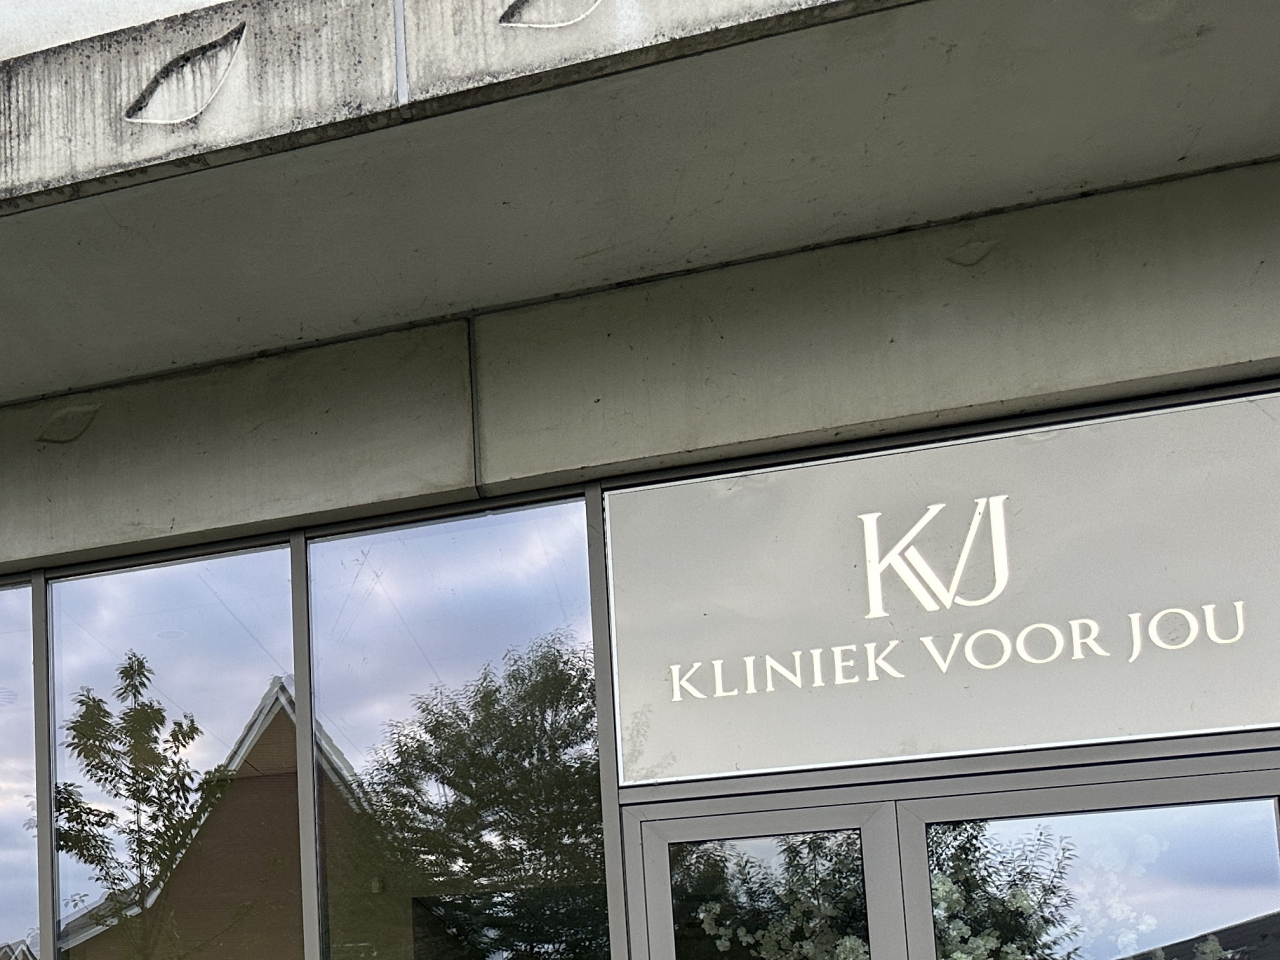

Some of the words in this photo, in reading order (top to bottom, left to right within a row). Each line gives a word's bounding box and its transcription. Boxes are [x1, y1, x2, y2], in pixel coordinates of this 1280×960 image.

[857, 495, 1009, 619] KVJ
[670, 640, 905, 702] KLINIEK
[920, 618, 1111, 673] VOOR
[1128, 601, 1245, 663] JOU
